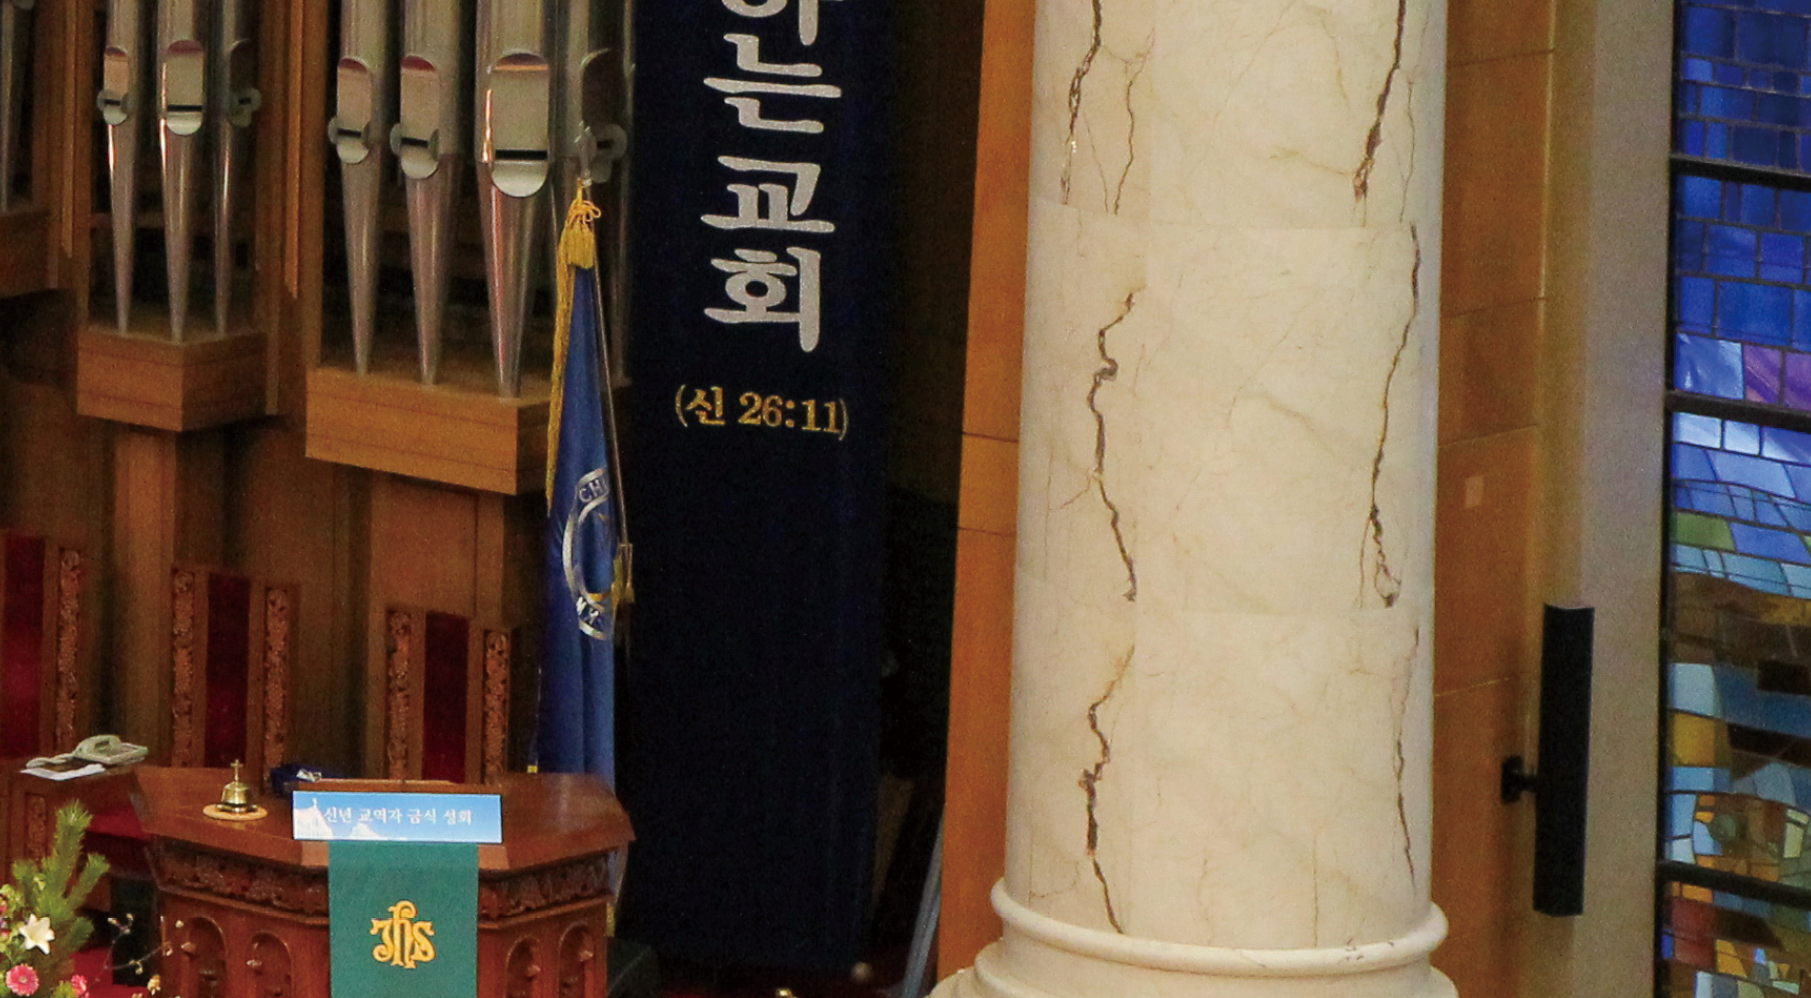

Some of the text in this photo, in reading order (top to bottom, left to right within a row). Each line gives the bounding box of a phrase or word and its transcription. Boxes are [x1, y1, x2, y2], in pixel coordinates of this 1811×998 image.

[700, 155, 836, 352] 교회
[675, 384, 850, 441] (신 26:11)
[323, 806, 353, 824] 신년
[357, 807, 403, 824] 교역자
[406, 808, 438, 825] 금식
